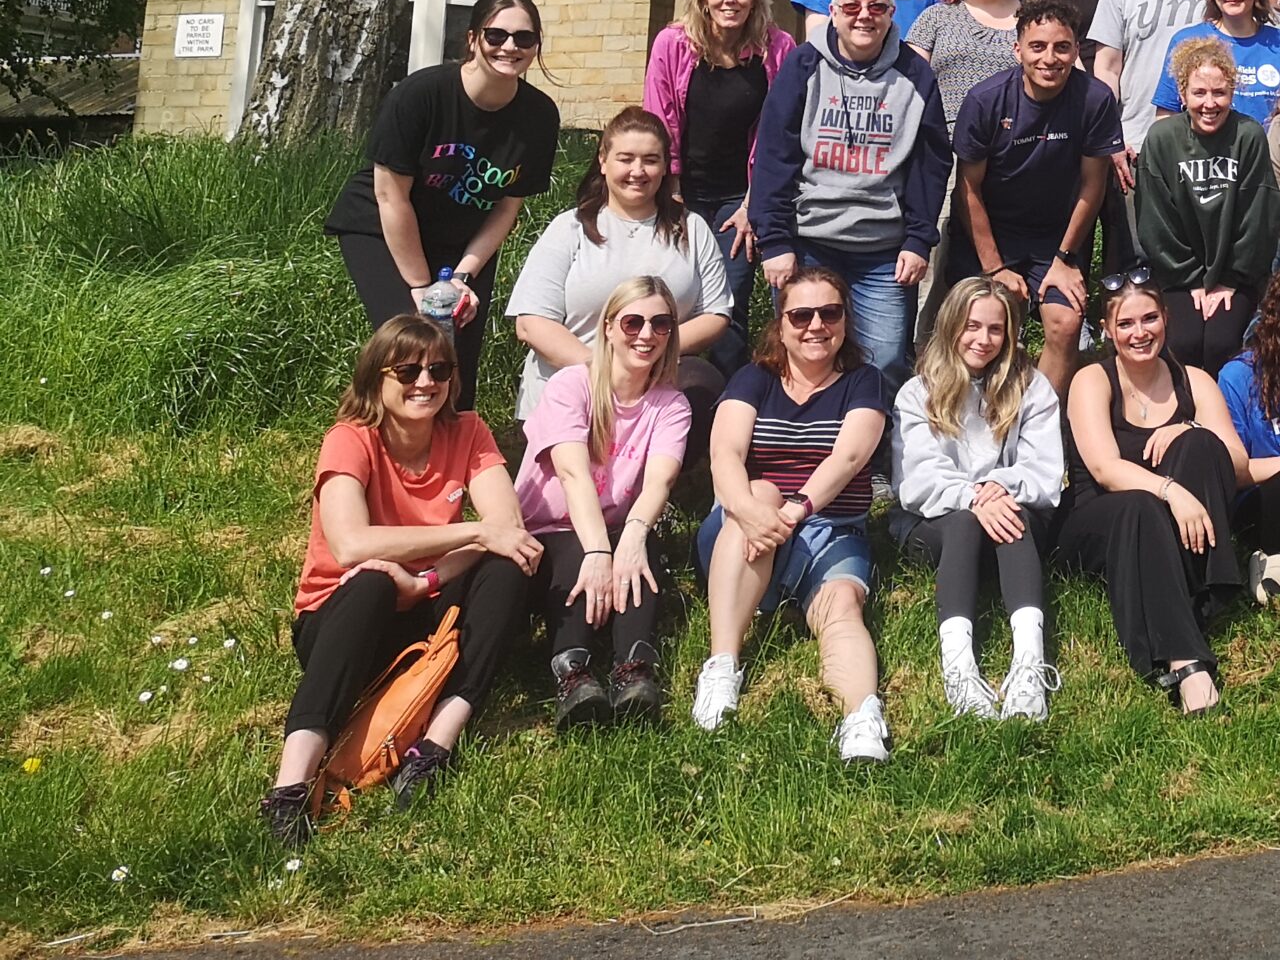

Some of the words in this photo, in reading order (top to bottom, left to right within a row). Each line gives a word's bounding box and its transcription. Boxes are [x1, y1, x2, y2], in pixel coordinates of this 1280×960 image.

[840, 95, 879, 112] READY
[820, 108, 893, 133] WILLING
[843, 132, 867, 144] AND
[1013, 135, 1036, 146] TOMMY
[1046, 132, 1069, 141] JEANS
[431, 143, 476, 160] IT'S
[813, 141, 891, 176] GABLE
[1178, 156, 1239, 183] NIKE
[425, 172, 455, 190] BE
